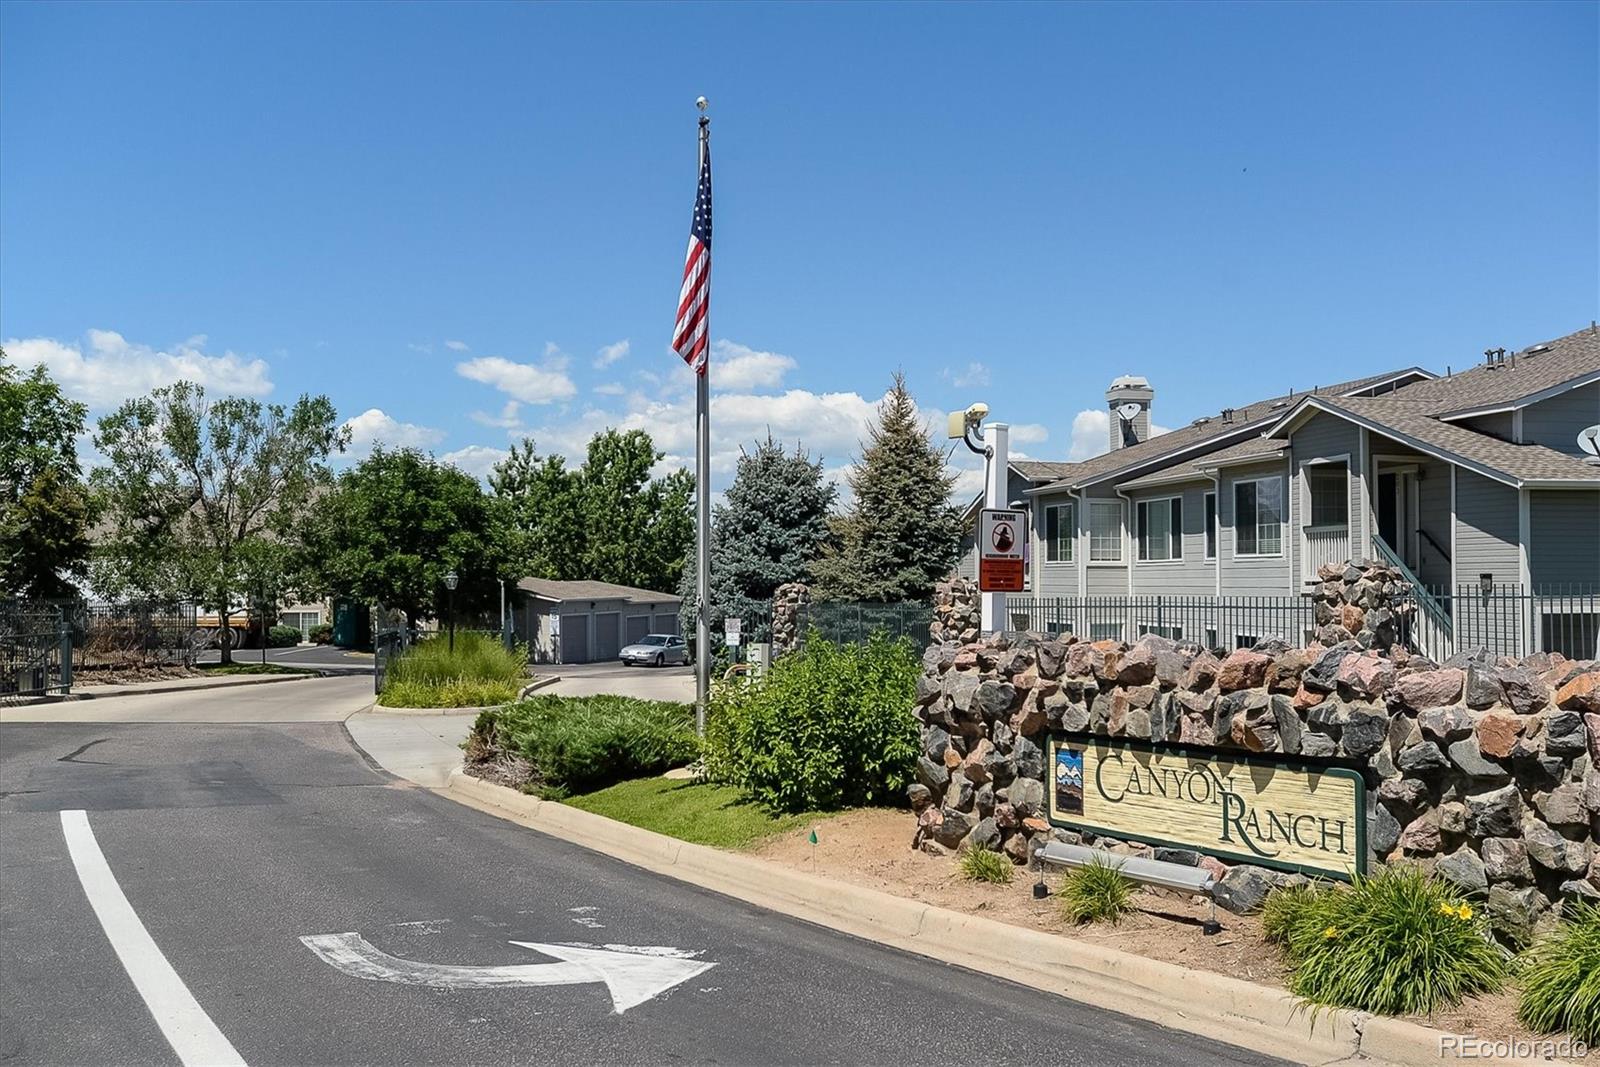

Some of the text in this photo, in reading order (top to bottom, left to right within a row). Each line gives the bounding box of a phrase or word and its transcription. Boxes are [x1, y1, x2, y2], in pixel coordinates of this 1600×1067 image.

[991, 513, 1016, 521] WARNING
[1095, 755, 1235, 806] CANYON
[1217, 790, 1348, 857] RANCH
